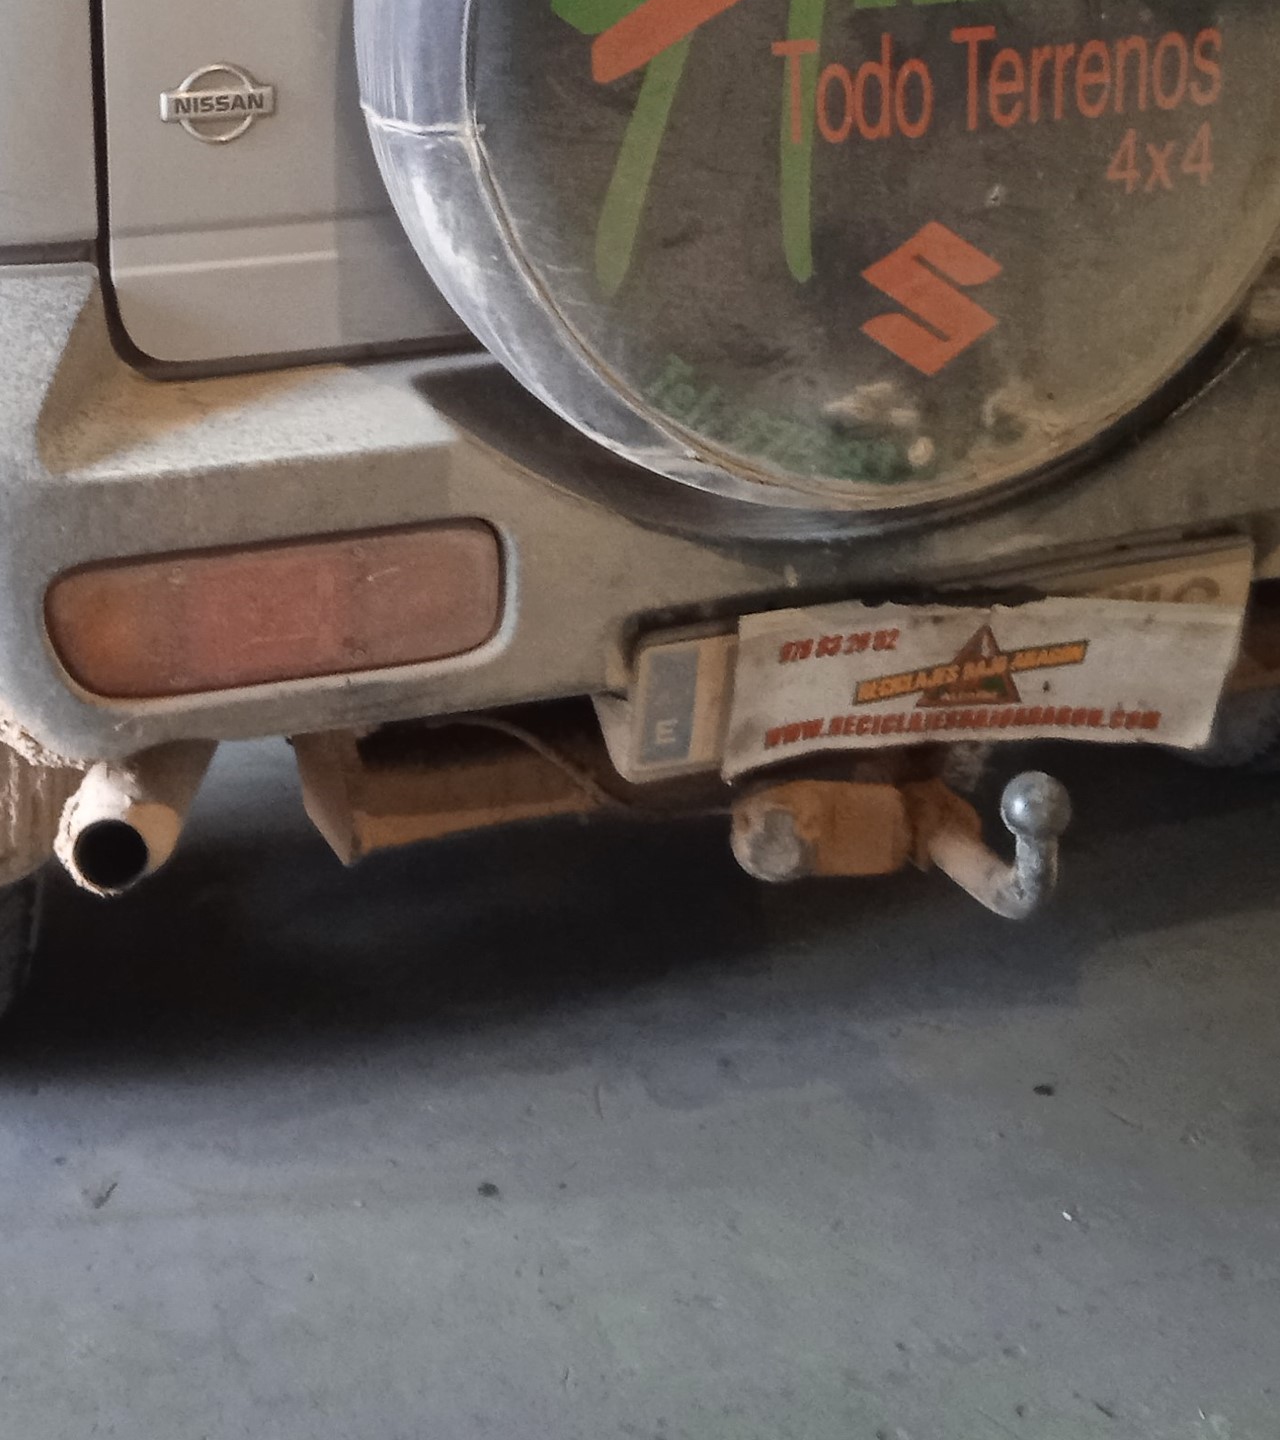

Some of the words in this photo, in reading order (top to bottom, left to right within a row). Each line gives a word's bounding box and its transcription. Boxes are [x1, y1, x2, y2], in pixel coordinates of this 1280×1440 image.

[174, 93, 265, 115] NISSAN
[770, 34, 934, 146] Todo
[950, 26, 1223, 131] Terrenos
[1107, 123, 1216, 196] 4x4
[654, 718, 679, 746] E
